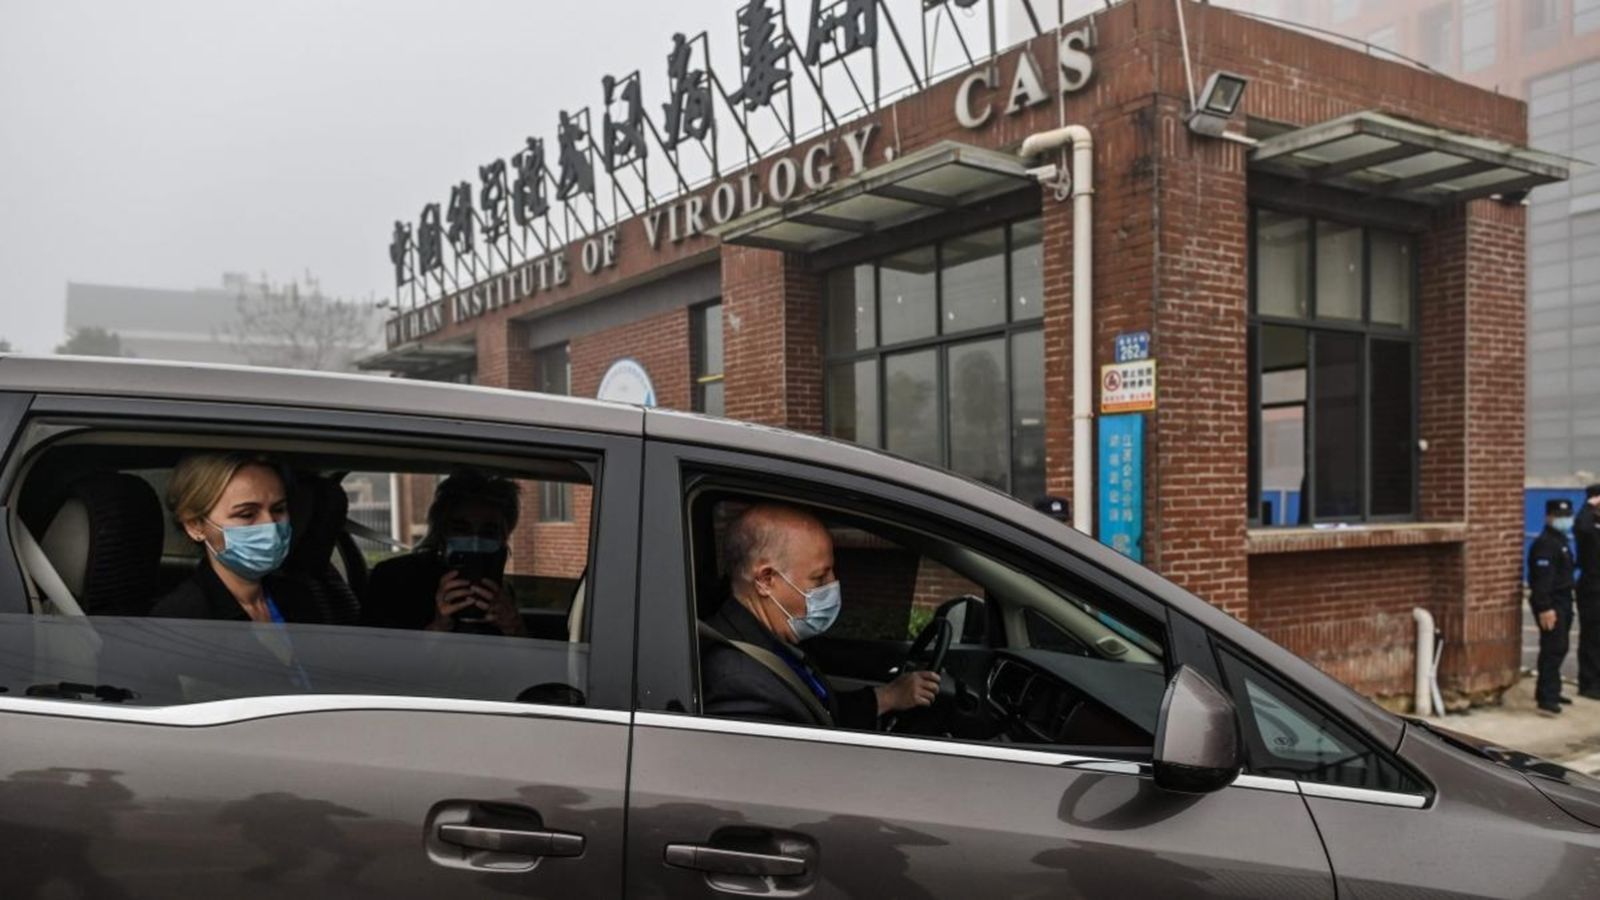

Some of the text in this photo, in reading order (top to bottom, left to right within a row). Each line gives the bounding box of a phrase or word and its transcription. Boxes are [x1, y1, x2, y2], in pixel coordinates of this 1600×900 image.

[452, 252, 567, 322] INSTITUTE
[581, 229, 617, 274] OF
[642, 123, 894, 249] VIROLOGY,
[955, 29, 1093, 128] CAS
